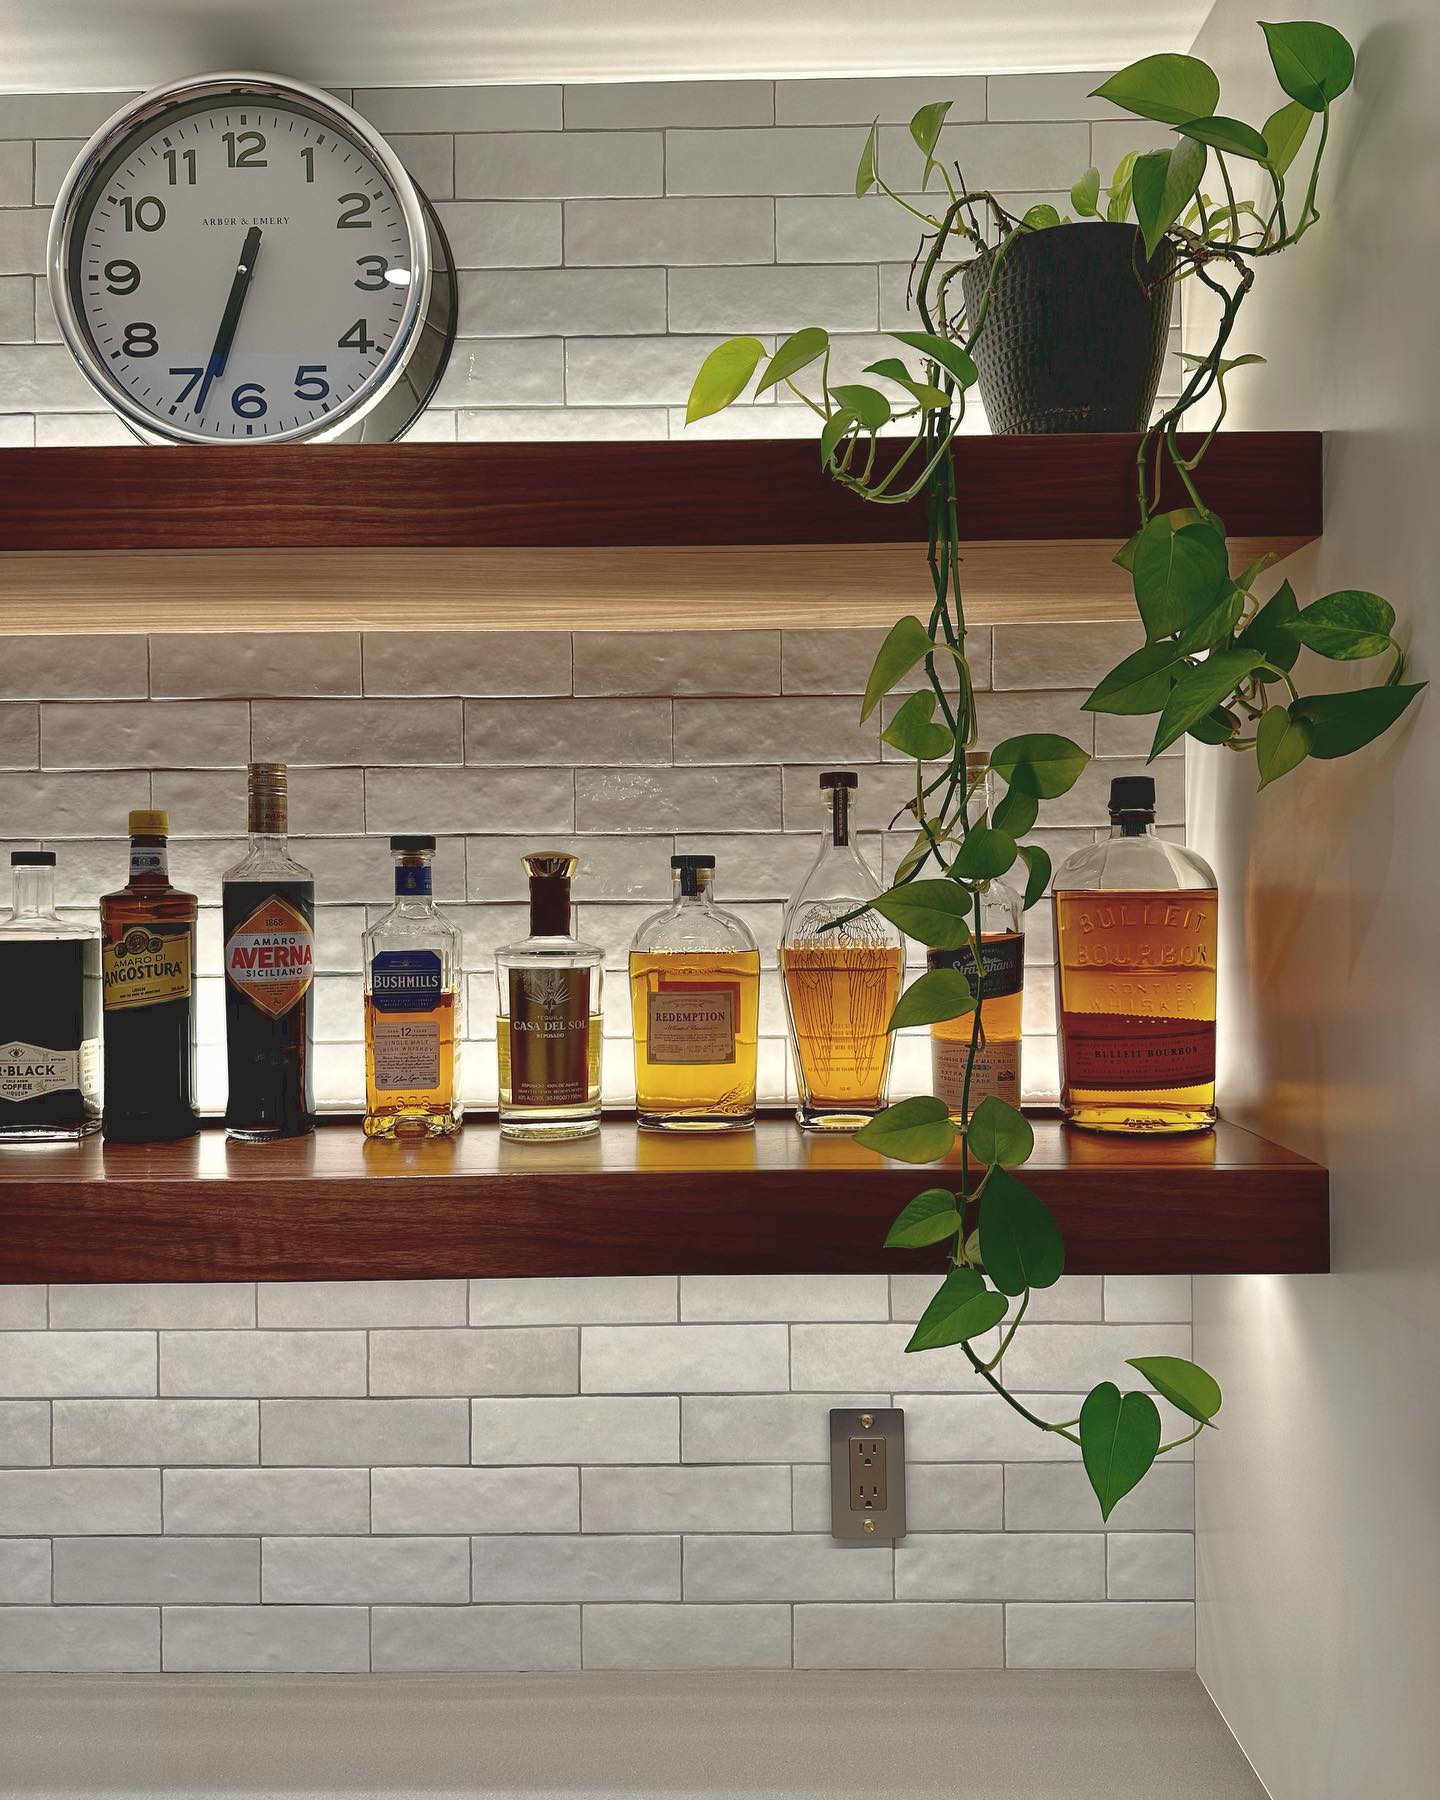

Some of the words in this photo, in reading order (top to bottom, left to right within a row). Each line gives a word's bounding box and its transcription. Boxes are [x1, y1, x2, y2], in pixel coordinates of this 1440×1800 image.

[221, 131, 268, 168] 12
[163, 149, 197, 185] 11
[300, 147, 315, 183] 1
[119, 195, 166, 233] 10
[202, 218, 236, 226] ARBOR
[253, 217, 290, 225] EMERY
[336, 192, 373, 229] 2
[103, 259, 141, 296] 9
[353, 255, 391, 292] 3
[121, 322, 160, 359] 8
[337, 318, 375, 355] 4
[168, 367, 204, 404] 7
[293, 365, 330, 401] 5
[231, 382, 268, 419] 6
[265, 919, 284, 927] 1868
[1079, 904, 1207, 935] BULLEIT
[253, 937, 296, 946] AMARO
[1079, 943, 1207, 964] BOURBON
[114, 956, 152, 968] AMARO
[231, 944, 313, 969] AVERNA
[104, 961, 182, 988] ANGOSTURA
[246, 967, 303, 978] SICILIANO
[374, 975, 439, 989] BUSHMILLS
[656, 1011, 725, 1022] REDEMPTION
[1090, 998, 1203, 1012] WHISKEY
[401, 1027, 412, 1037] 12
[513, 1021, 541, 1031] CASA
[544, 1021, 566, 1031] DEL
[568, 1020, 587, 1031] SOL
[1095, 1050, 1141, 1059] BULLEIT
[1147, 1046, 1198, 1058] BOURBON
